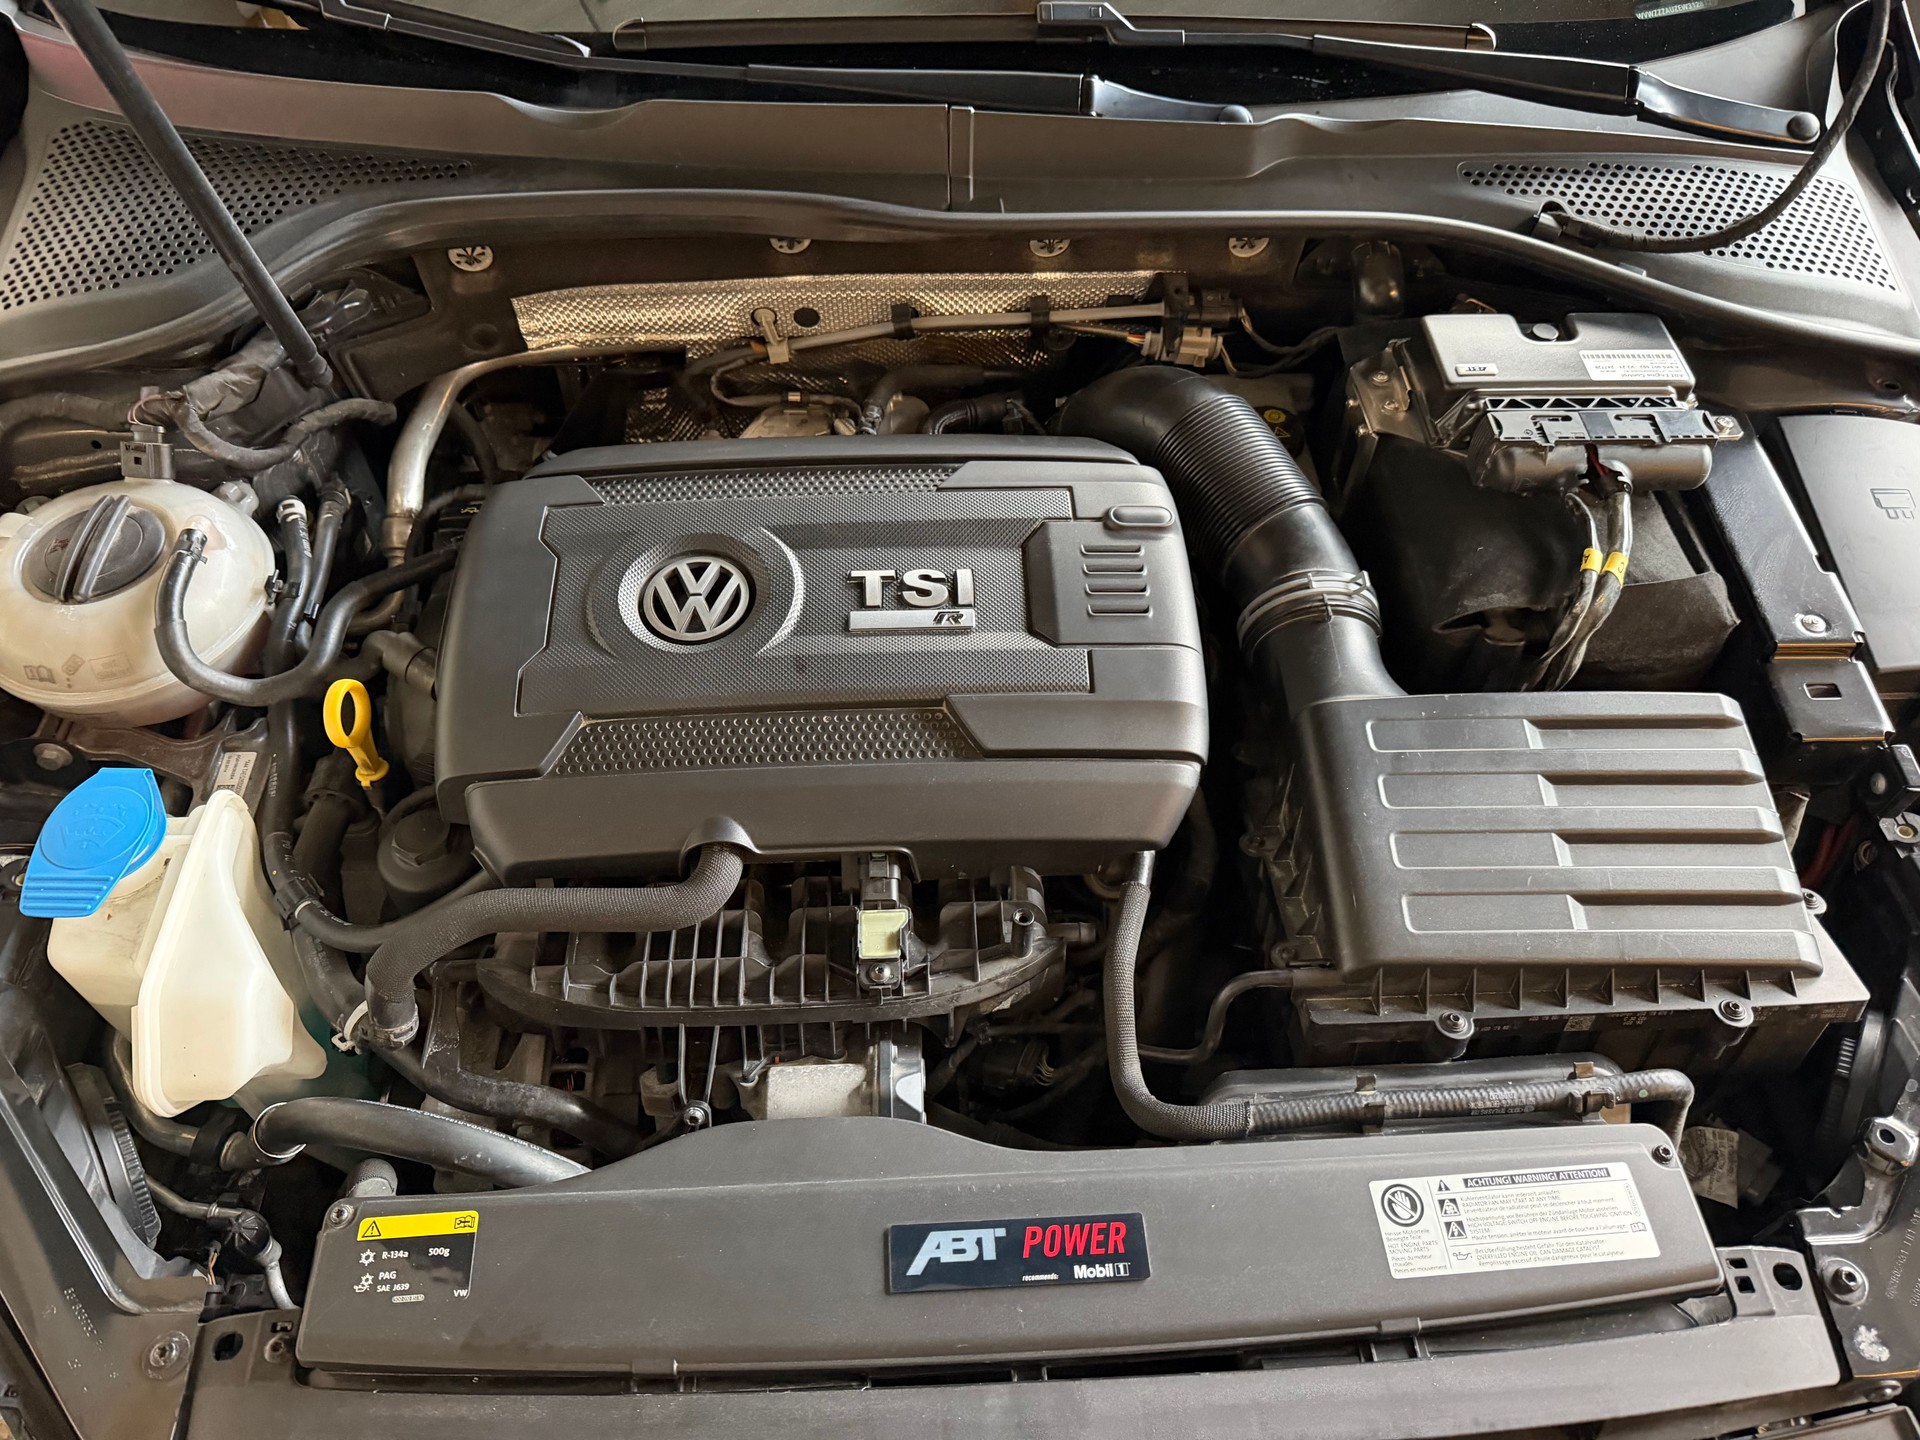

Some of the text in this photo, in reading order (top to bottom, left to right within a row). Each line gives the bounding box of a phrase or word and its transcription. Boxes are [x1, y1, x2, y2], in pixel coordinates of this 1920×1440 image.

[849, 568, 974, 608] TSI
[643, 556, 750, 641] VW
[932, 610, 965, 626] R
[1467, 1170, 1608, 1187] ACHTUNG! WARNING! ATTENTION!
[381, 1247, 450, 1259] R-134a 500g
[906, 1222, 1127, 1275] ABT POWER
[378, 1271, 397, 1280] PAG
[1074, 1263, 1113, 1280] Mobil
[376, 1283, 410, 1292] SAE J639
[453, 1289, 468, 1297] VW
